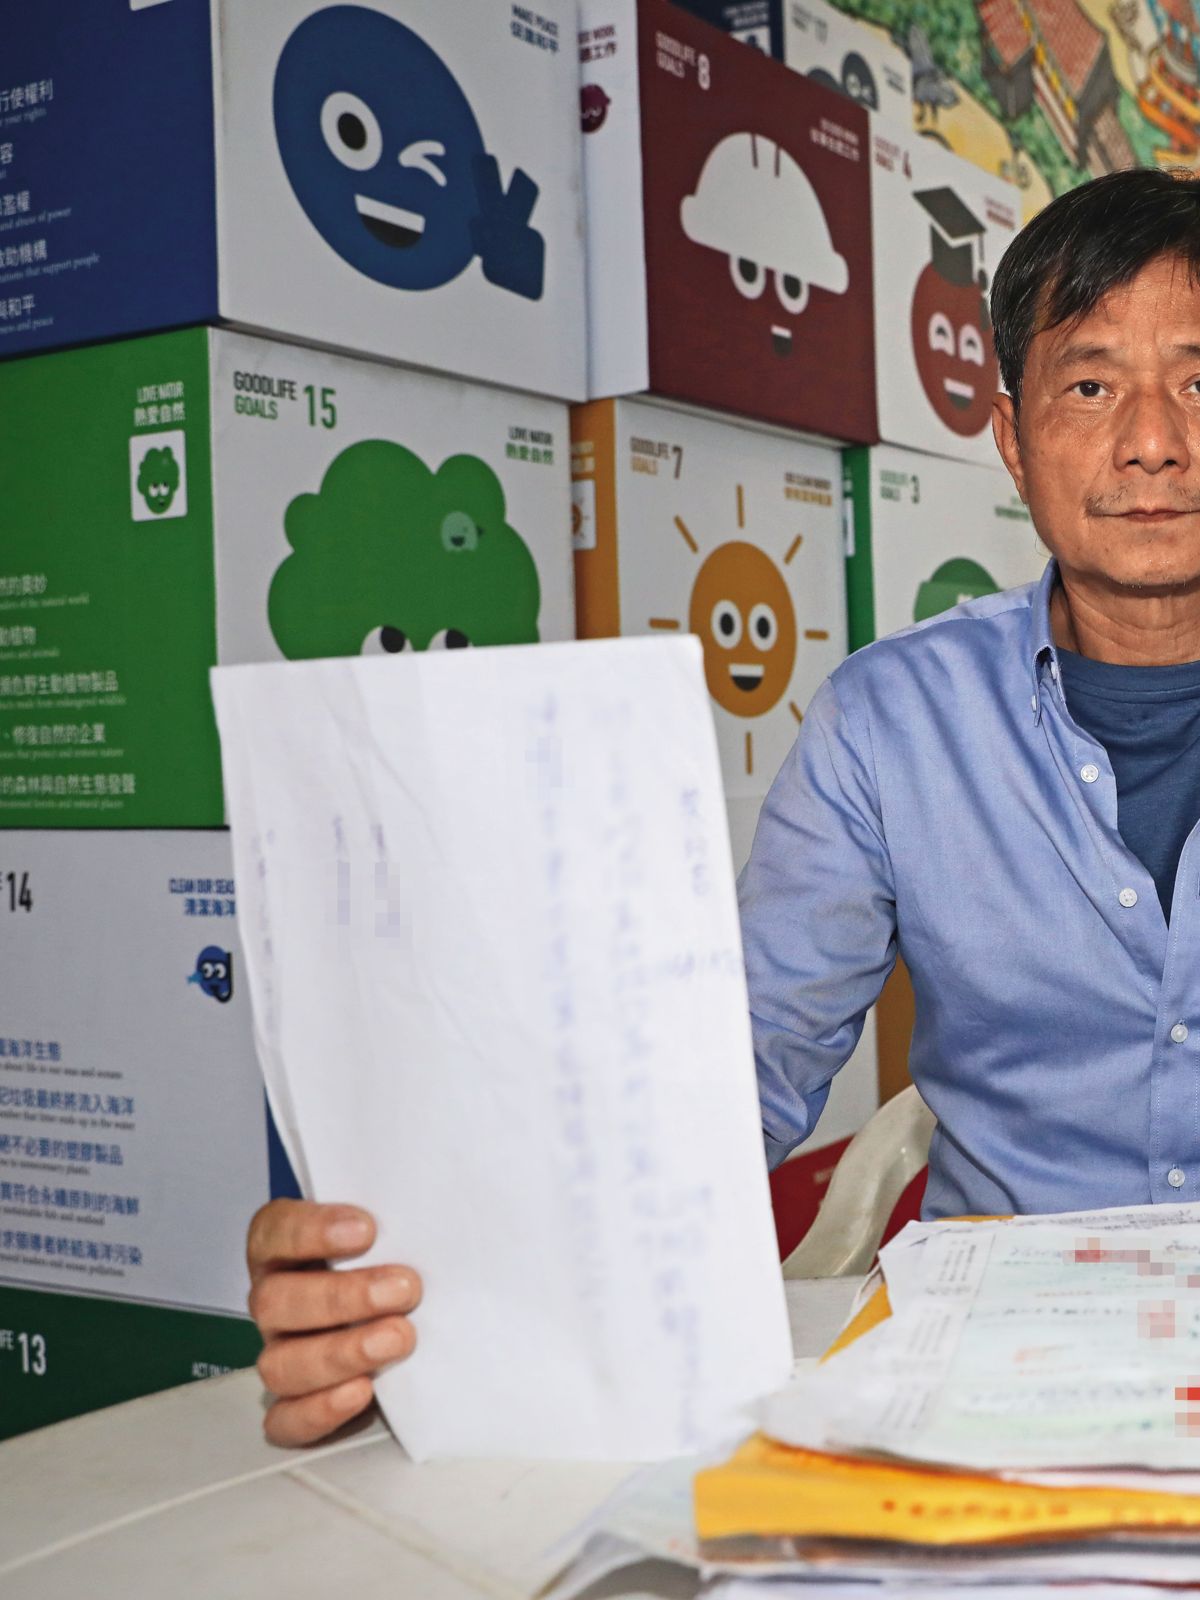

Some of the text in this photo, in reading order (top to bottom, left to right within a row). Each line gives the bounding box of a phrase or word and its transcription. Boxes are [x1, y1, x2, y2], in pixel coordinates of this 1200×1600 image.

[656, 52, 711, 90] GOALS 8
[233, 371, 298, 400] GOODLIFE
[234, 384, 337, 430] GOALS 15
[672, 444, 684, 480] 7
[6, 871, 34, 913] 14
[18, 1332, 47, 1376] 13
